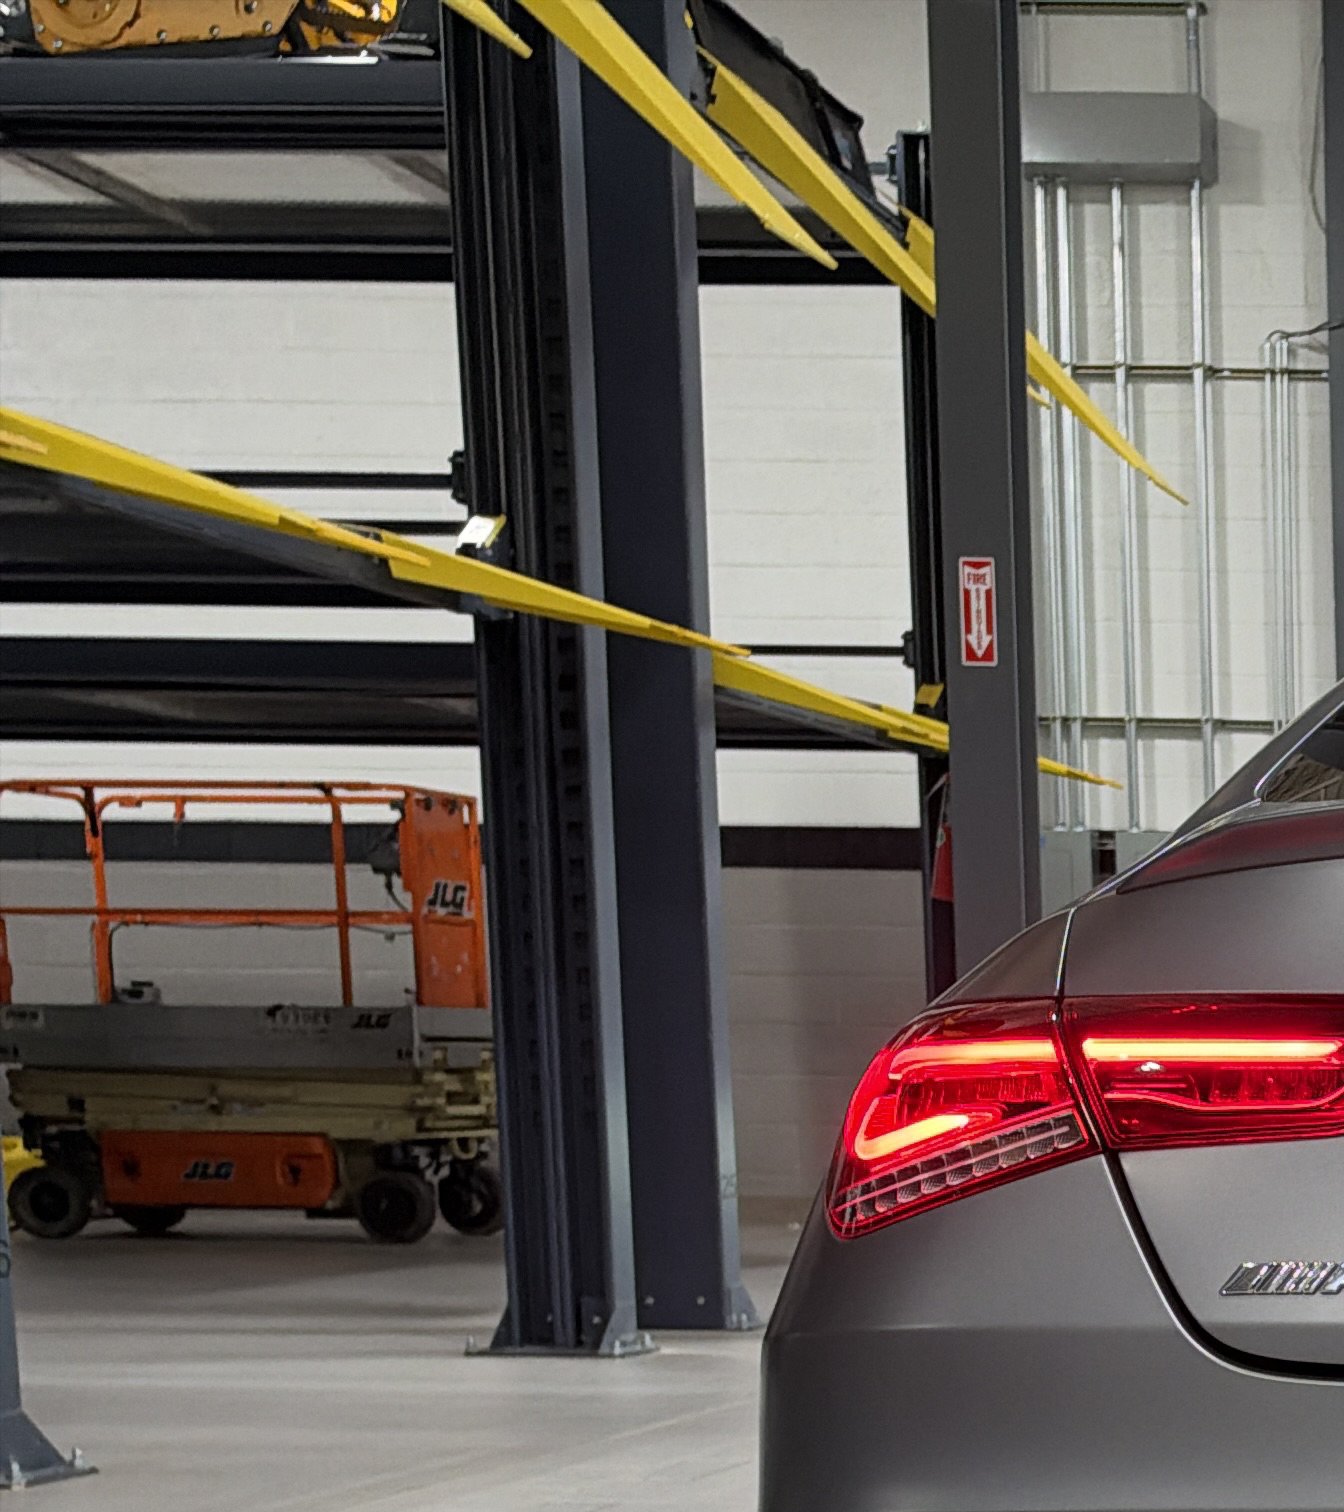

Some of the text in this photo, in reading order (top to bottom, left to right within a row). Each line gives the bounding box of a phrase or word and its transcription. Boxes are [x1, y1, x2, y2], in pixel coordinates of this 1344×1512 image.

[428, 882, 466, 910] JLG
[351, 1013, 392, 1028] JLG
[184, 1161, 234, 1180] JLG
